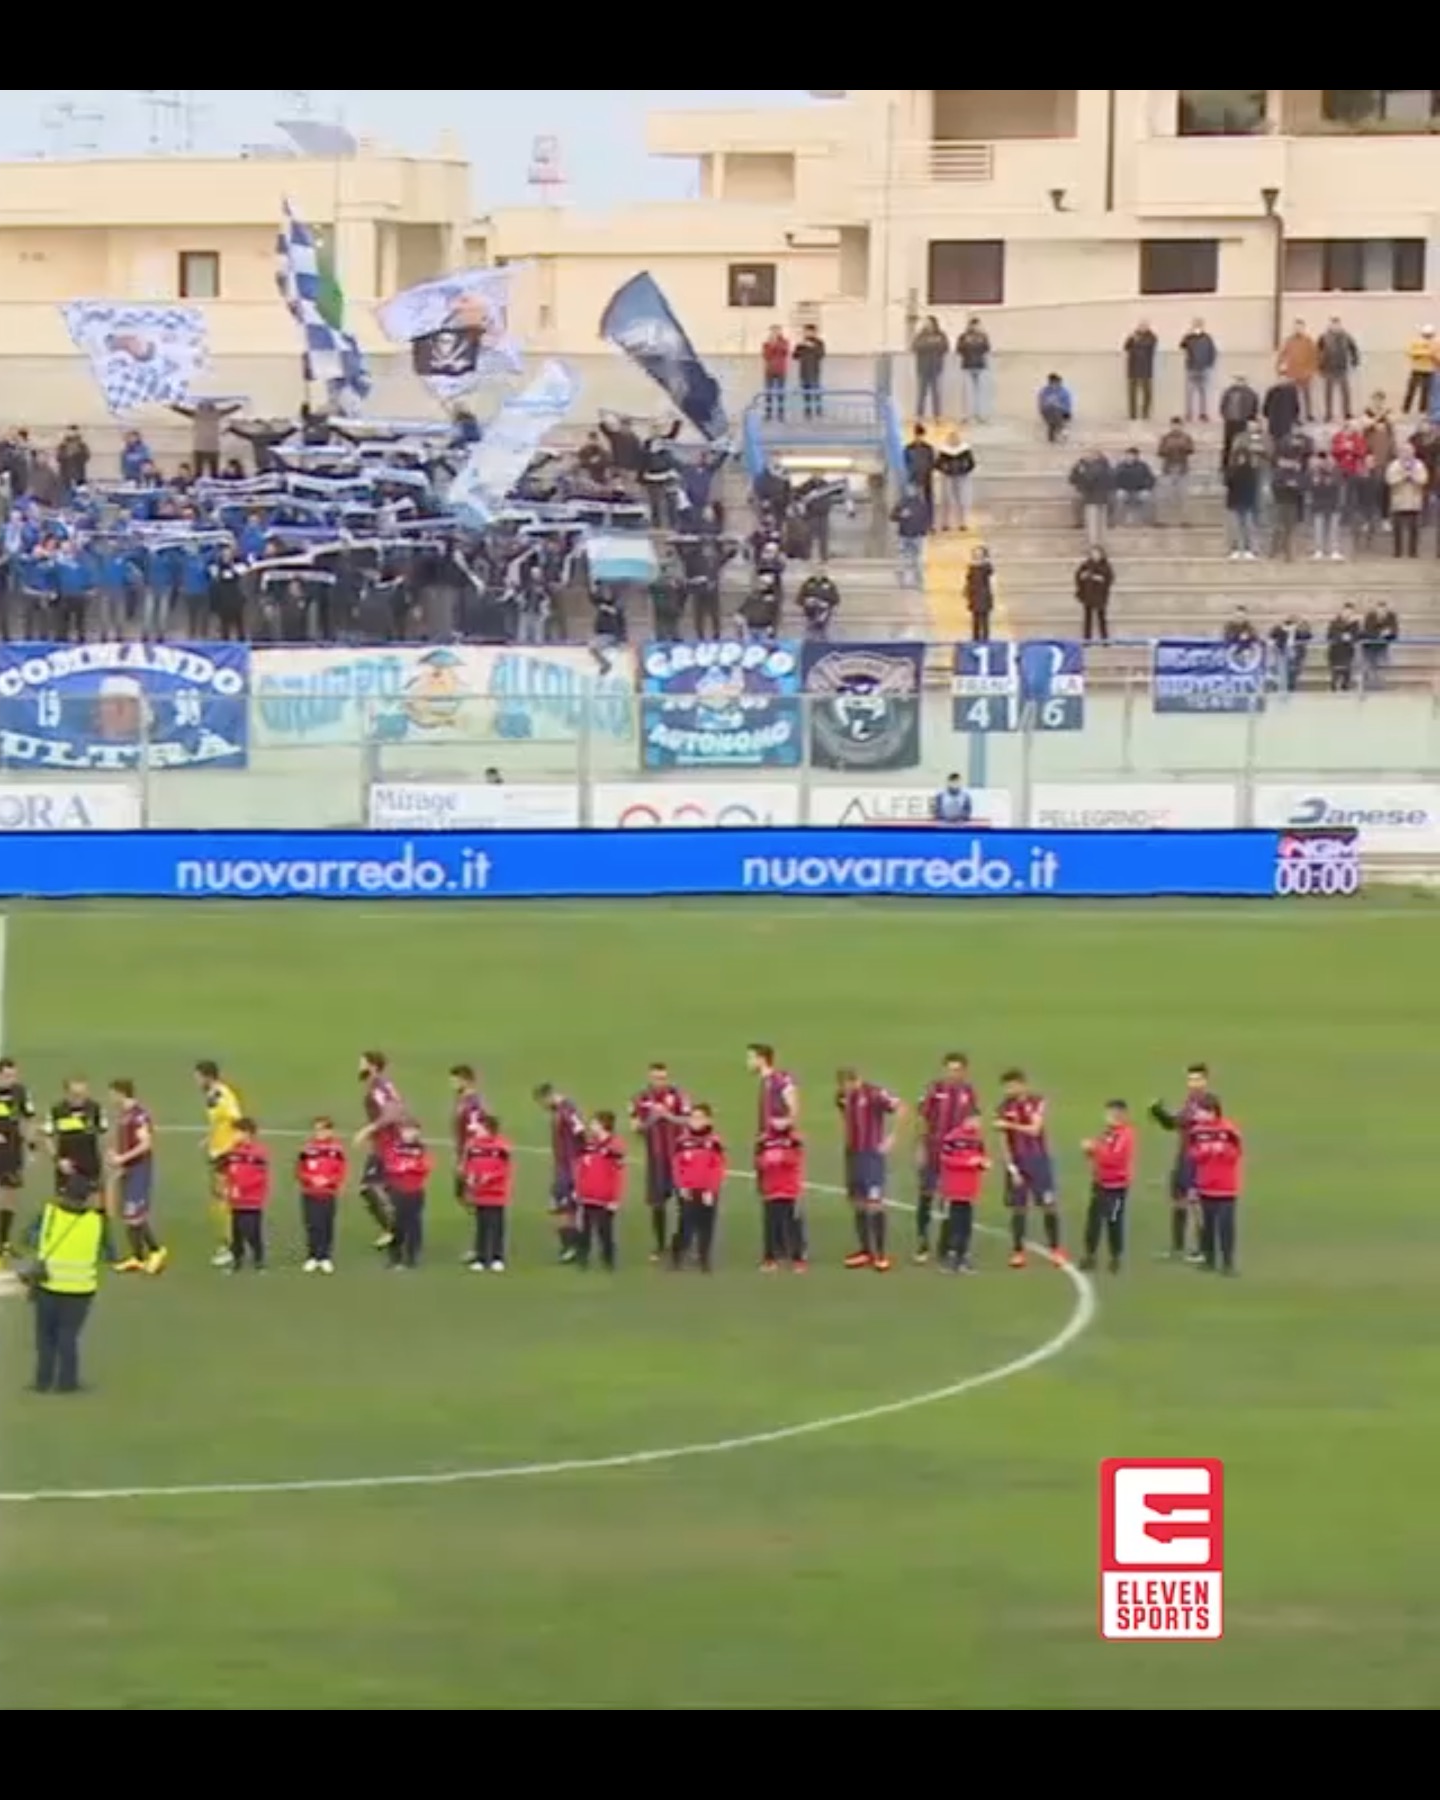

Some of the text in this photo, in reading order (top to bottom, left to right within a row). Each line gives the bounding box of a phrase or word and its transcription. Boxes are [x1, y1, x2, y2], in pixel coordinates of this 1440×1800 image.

[646, 642, 794, 678] GRUPPO
[967, 699, 1067, 728] 4 6
[648, 720, 791, 754] AUTONOMO
[177, 842, 491, 890] nuovarredo.it
[742, 839, 1058, 888] nuovarredo.it
[1275, 861, 1357, 894] 00:00
